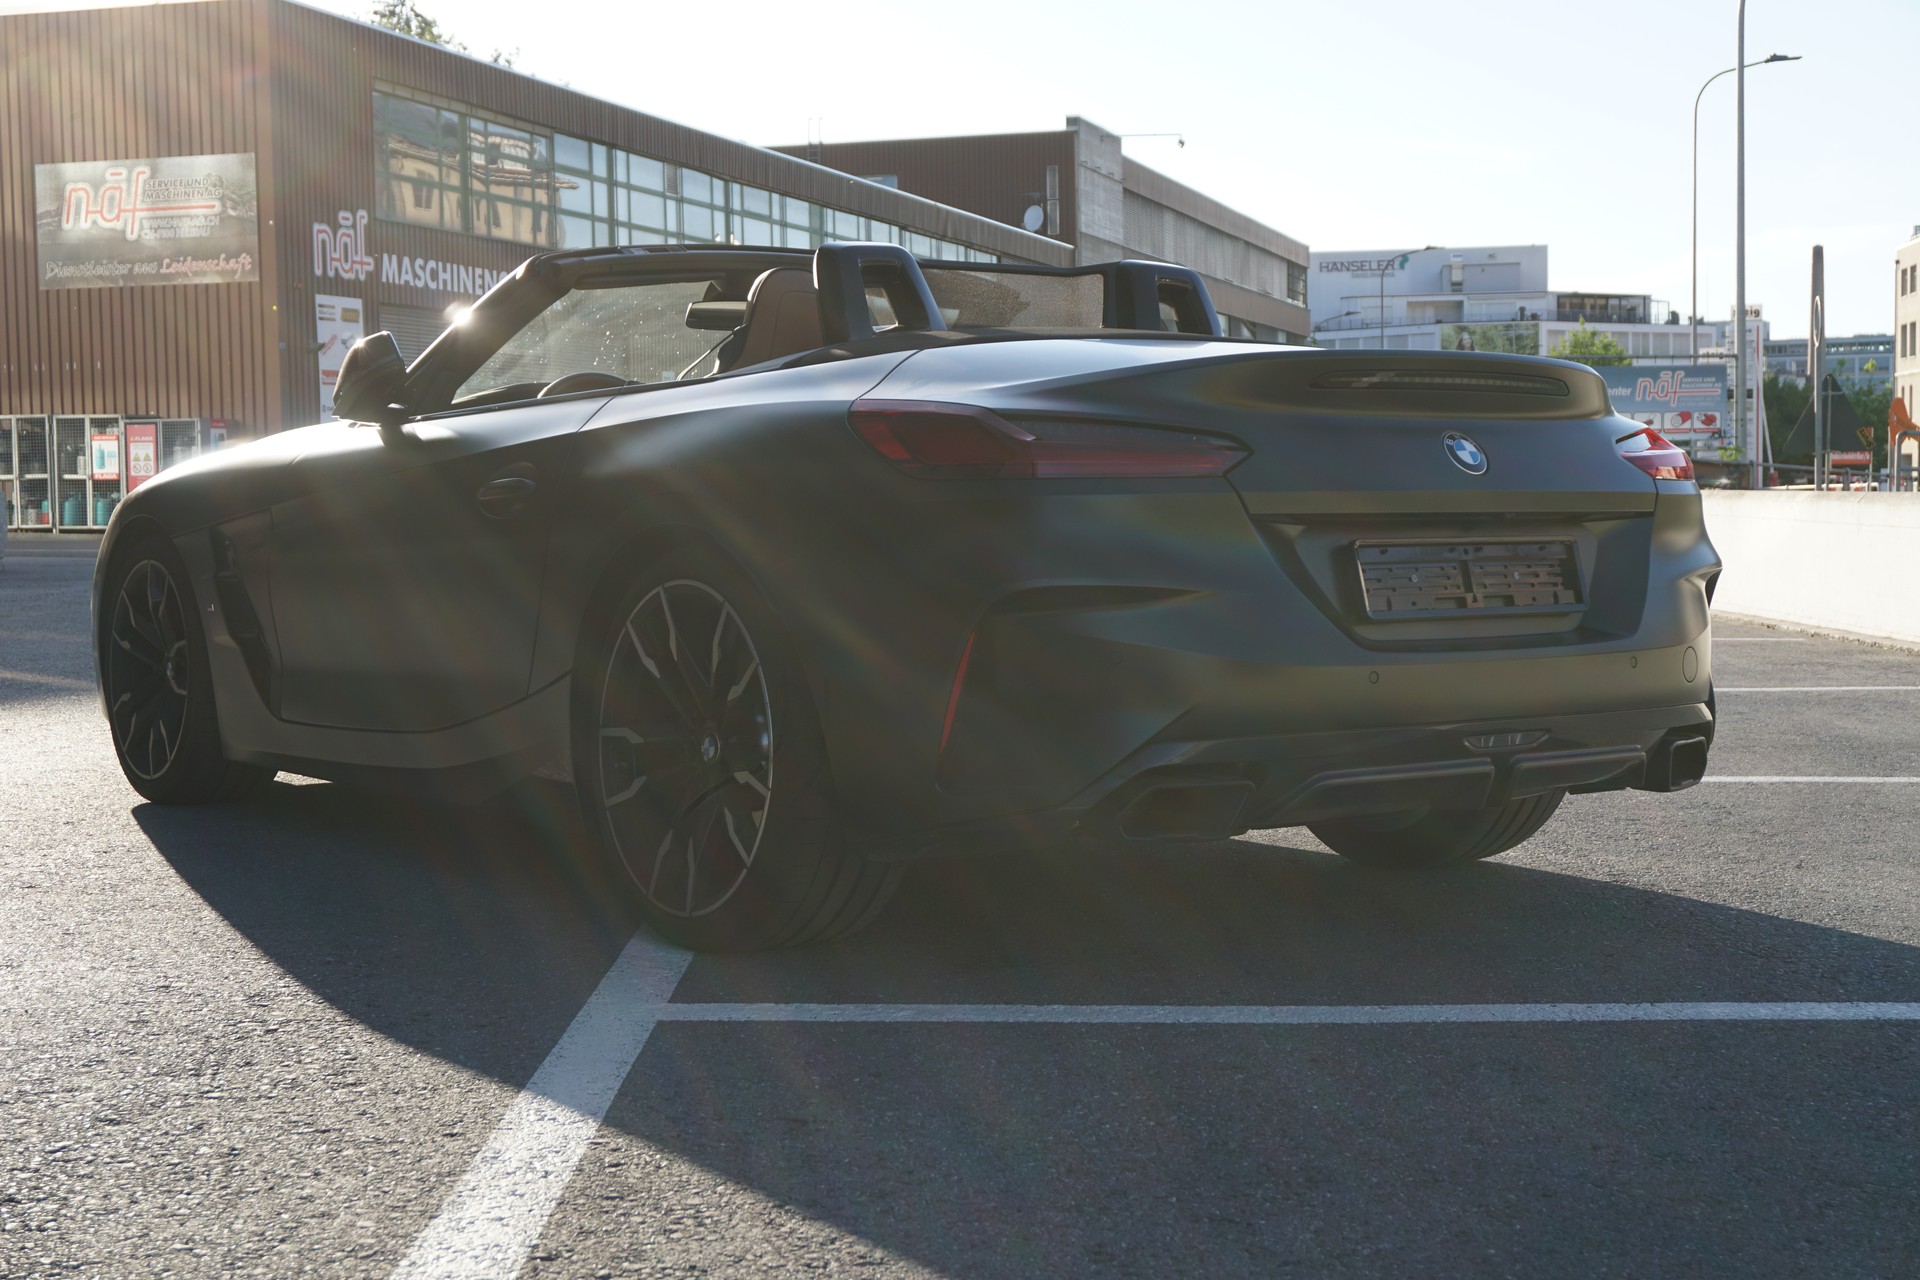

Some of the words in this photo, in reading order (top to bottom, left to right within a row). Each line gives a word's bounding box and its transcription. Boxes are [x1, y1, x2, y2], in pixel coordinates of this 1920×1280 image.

[145, 178, 184, 189] SERVICE
[186, 177, 209, 187] UND
[145, 189, 205, 200] MASCHINEN
[206, 188, 221, 197] AG
[45, 259, 131, 280] Dienstleister
[133, 260, 158, 274] aus
[159, 252, 252, 279] Leidenschaft
[1607, 386, 1632, 396] enter
